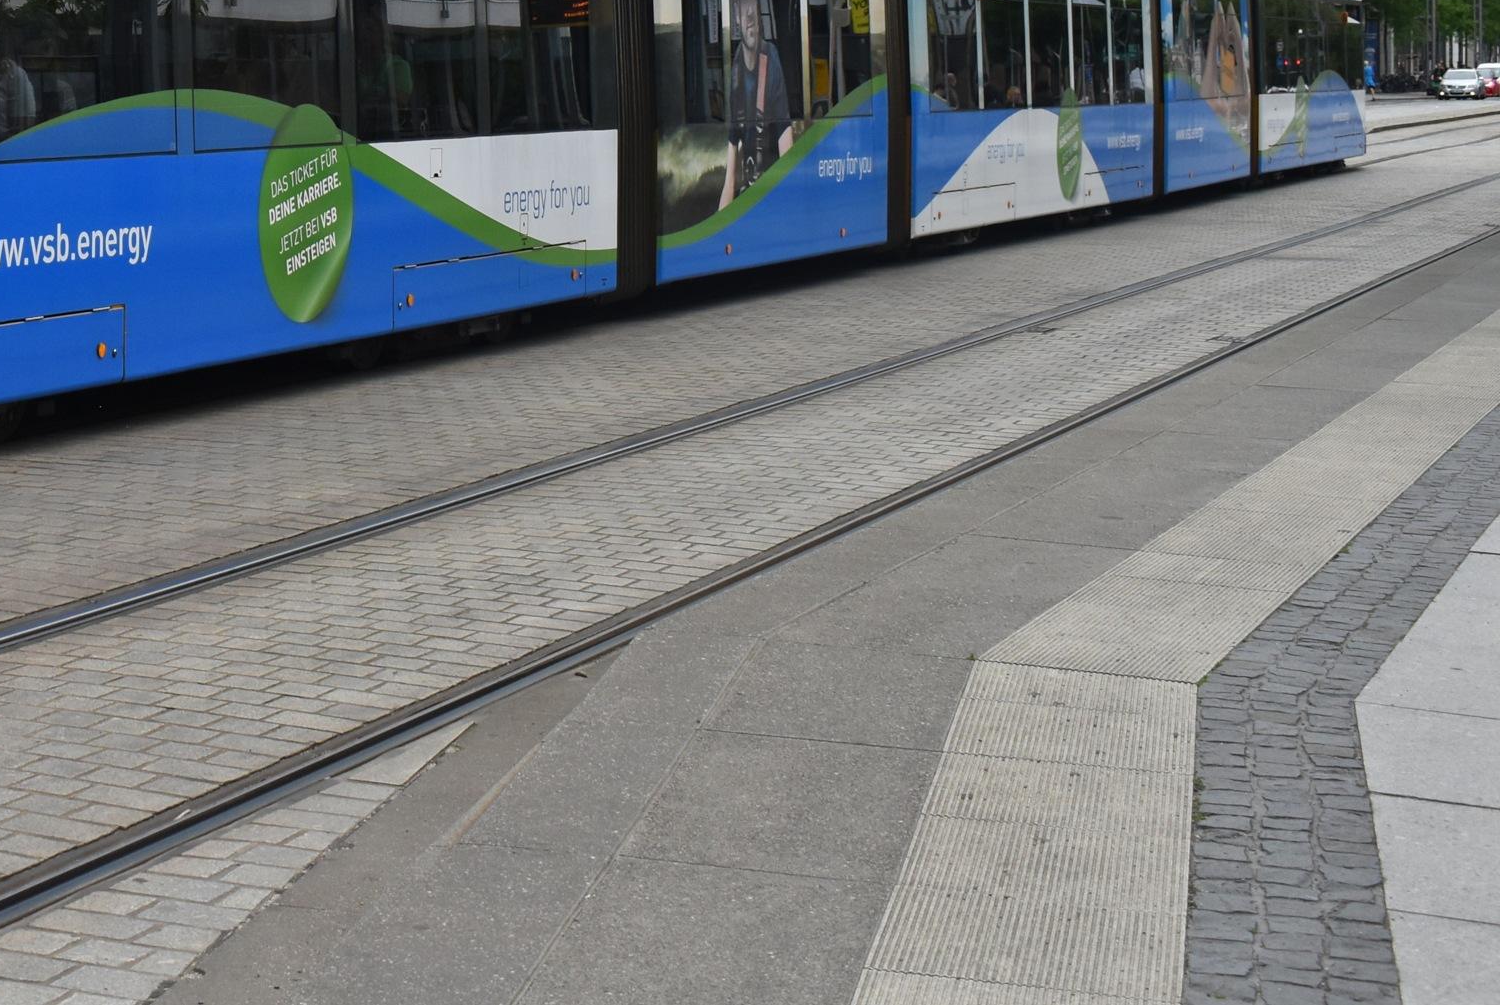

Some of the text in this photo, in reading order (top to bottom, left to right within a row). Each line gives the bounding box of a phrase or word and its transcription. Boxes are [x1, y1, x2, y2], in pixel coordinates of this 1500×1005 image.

[270, 148, 338, 198] DAS TICKET FÜR
[819, 151, 872, 182] energy for you
[269, 172, 342, 226] DEINE KARRIERE.
[504, 180, 590, 219] energy for you
[279, 206, 338, 255] JETZT BEI VSB
[286, 232, 336, 276] EINSTEIGEN
